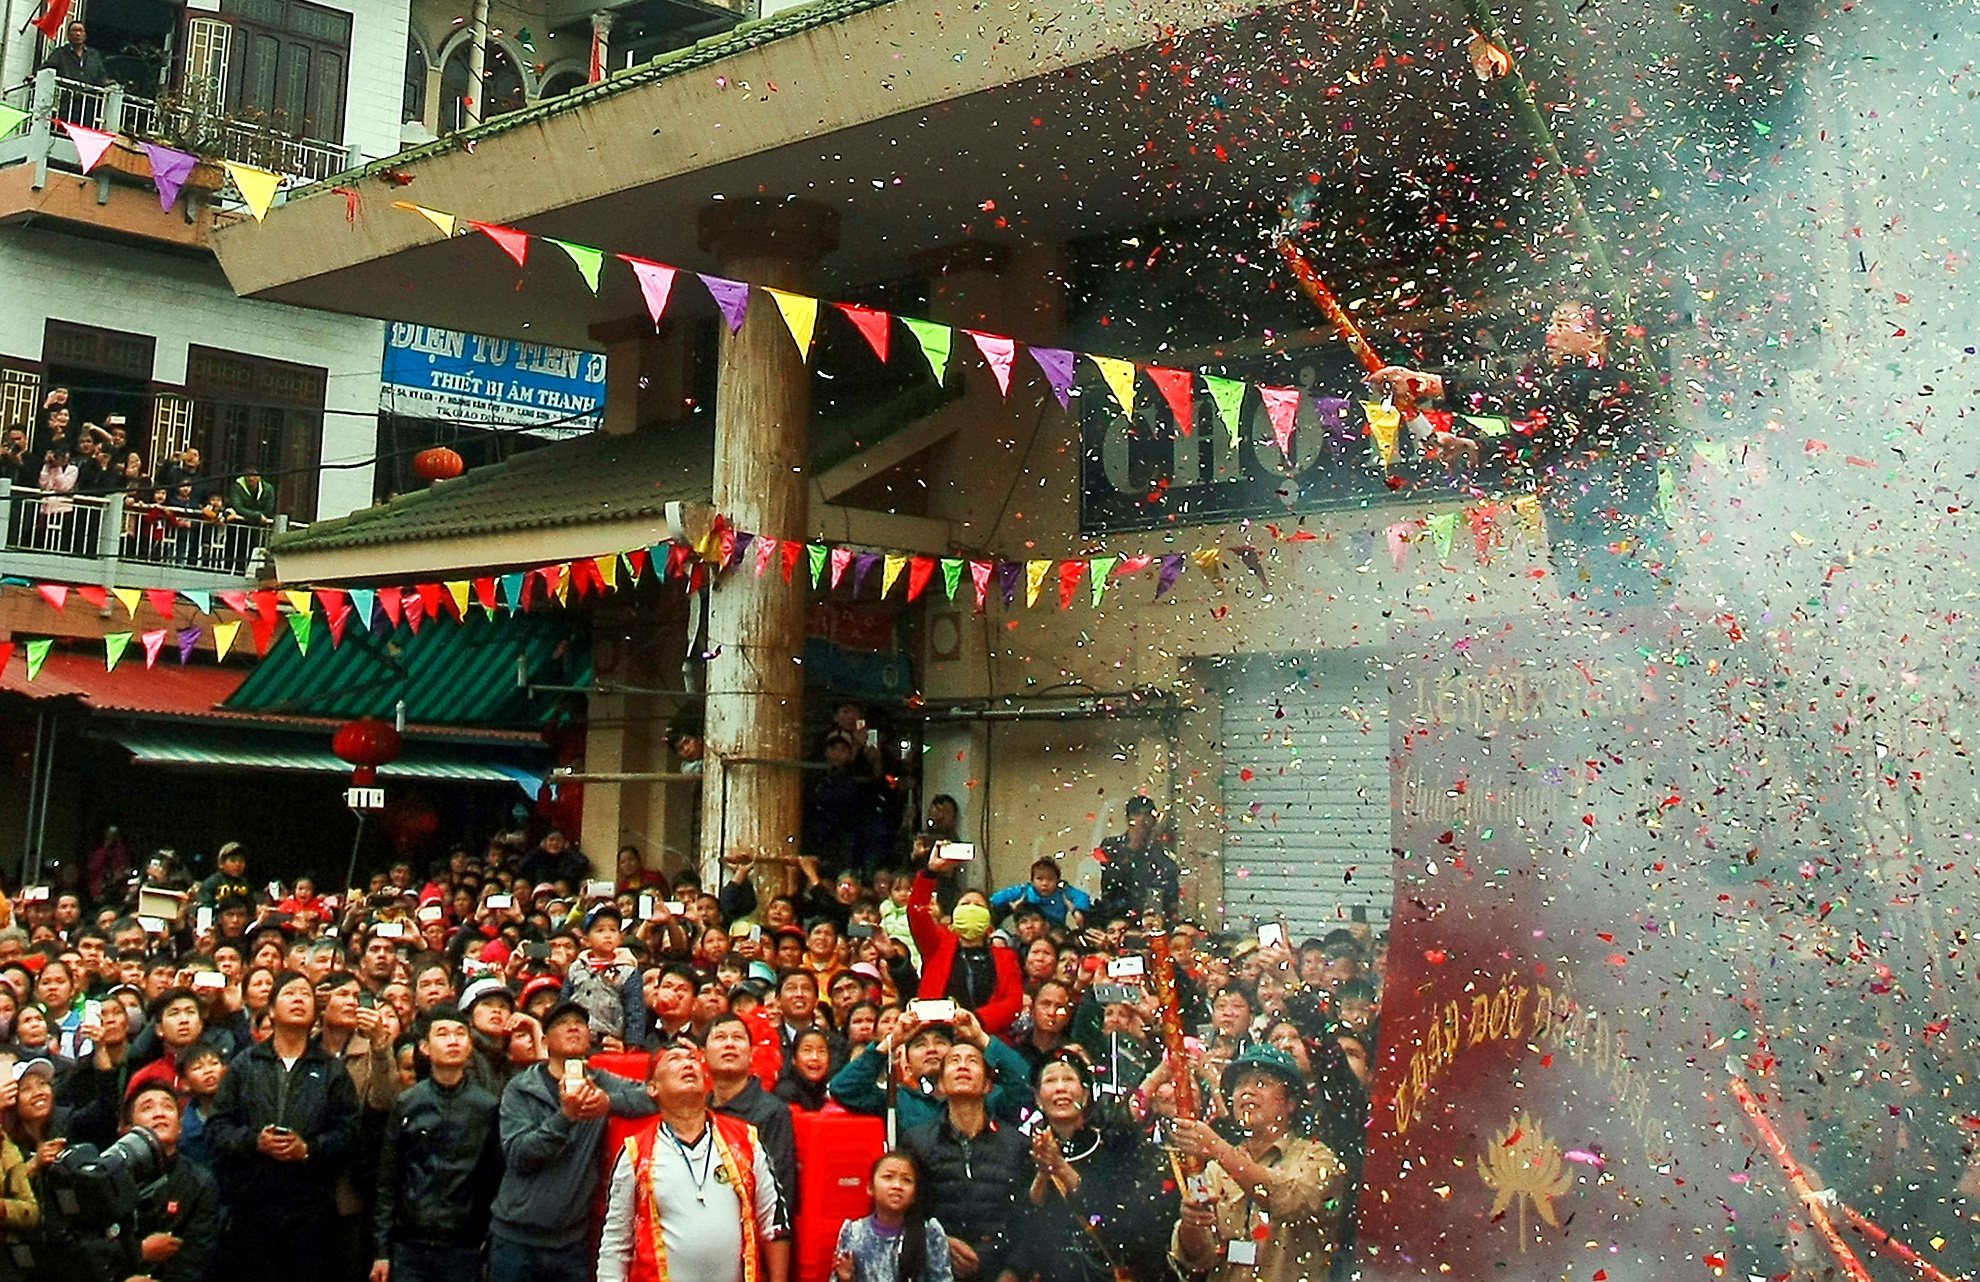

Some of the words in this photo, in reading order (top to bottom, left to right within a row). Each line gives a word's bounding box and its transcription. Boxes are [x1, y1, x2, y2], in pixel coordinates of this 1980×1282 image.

[430, 369, 483, 395] THIẾT
[485, 381, 503, 402] BỊ
[507, 380, 535, 403] ÂM
[537, 389, 597, 412] THANH
